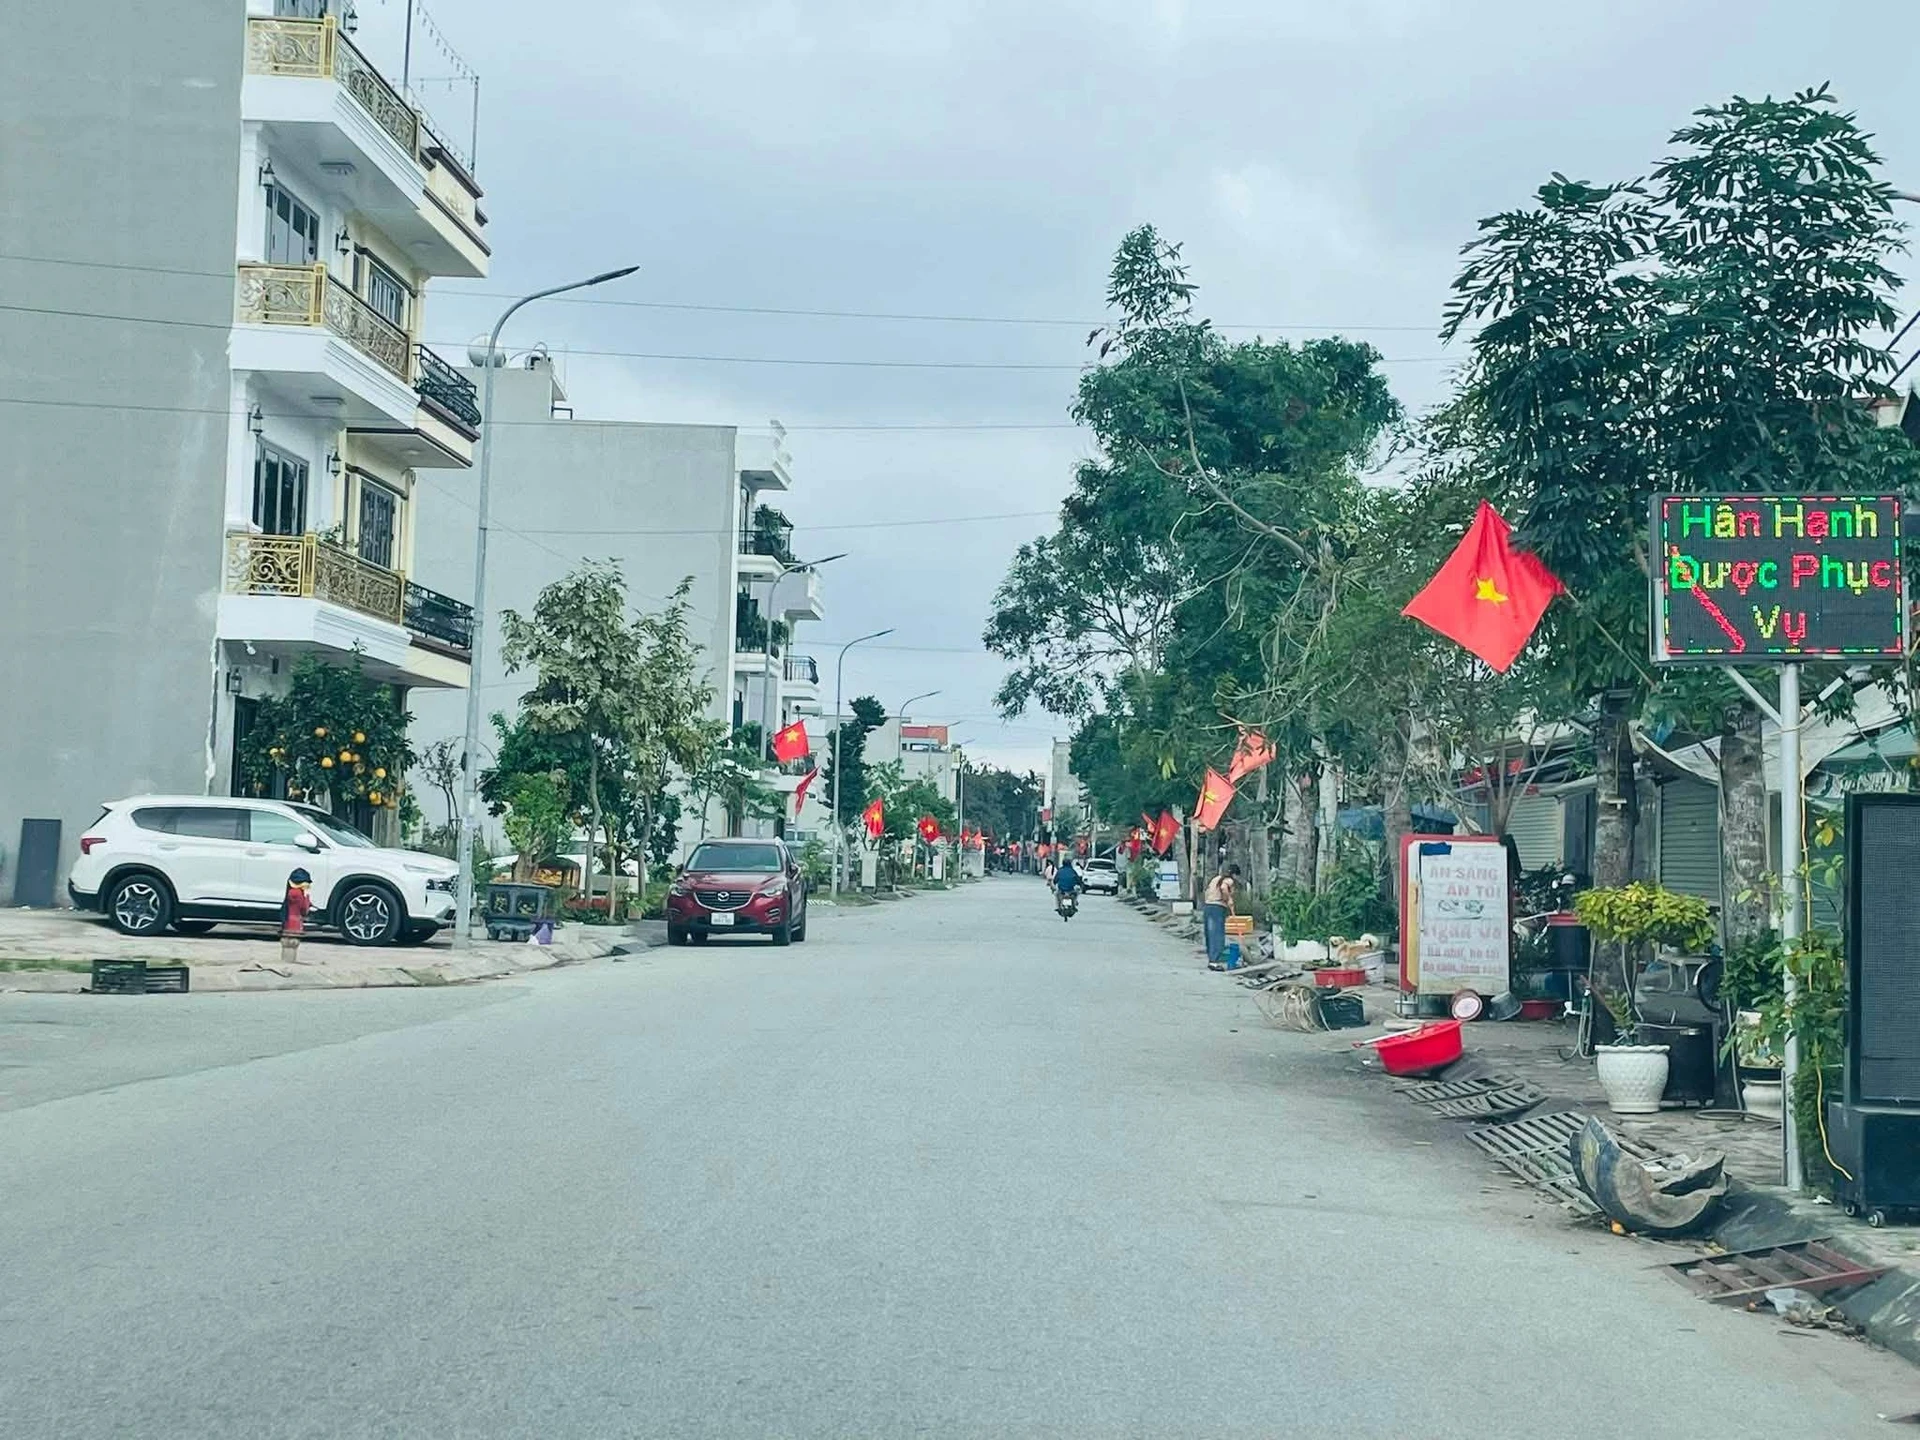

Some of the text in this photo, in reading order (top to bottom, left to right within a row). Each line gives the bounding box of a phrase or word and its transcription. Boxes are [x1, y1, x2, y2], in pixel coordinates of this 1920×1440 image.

[1682, 504, 1878, 545] Hân Hạnh
[1791, 554, 1891, 596] Phục
[1752, 604, 1806, 645] Vụ
